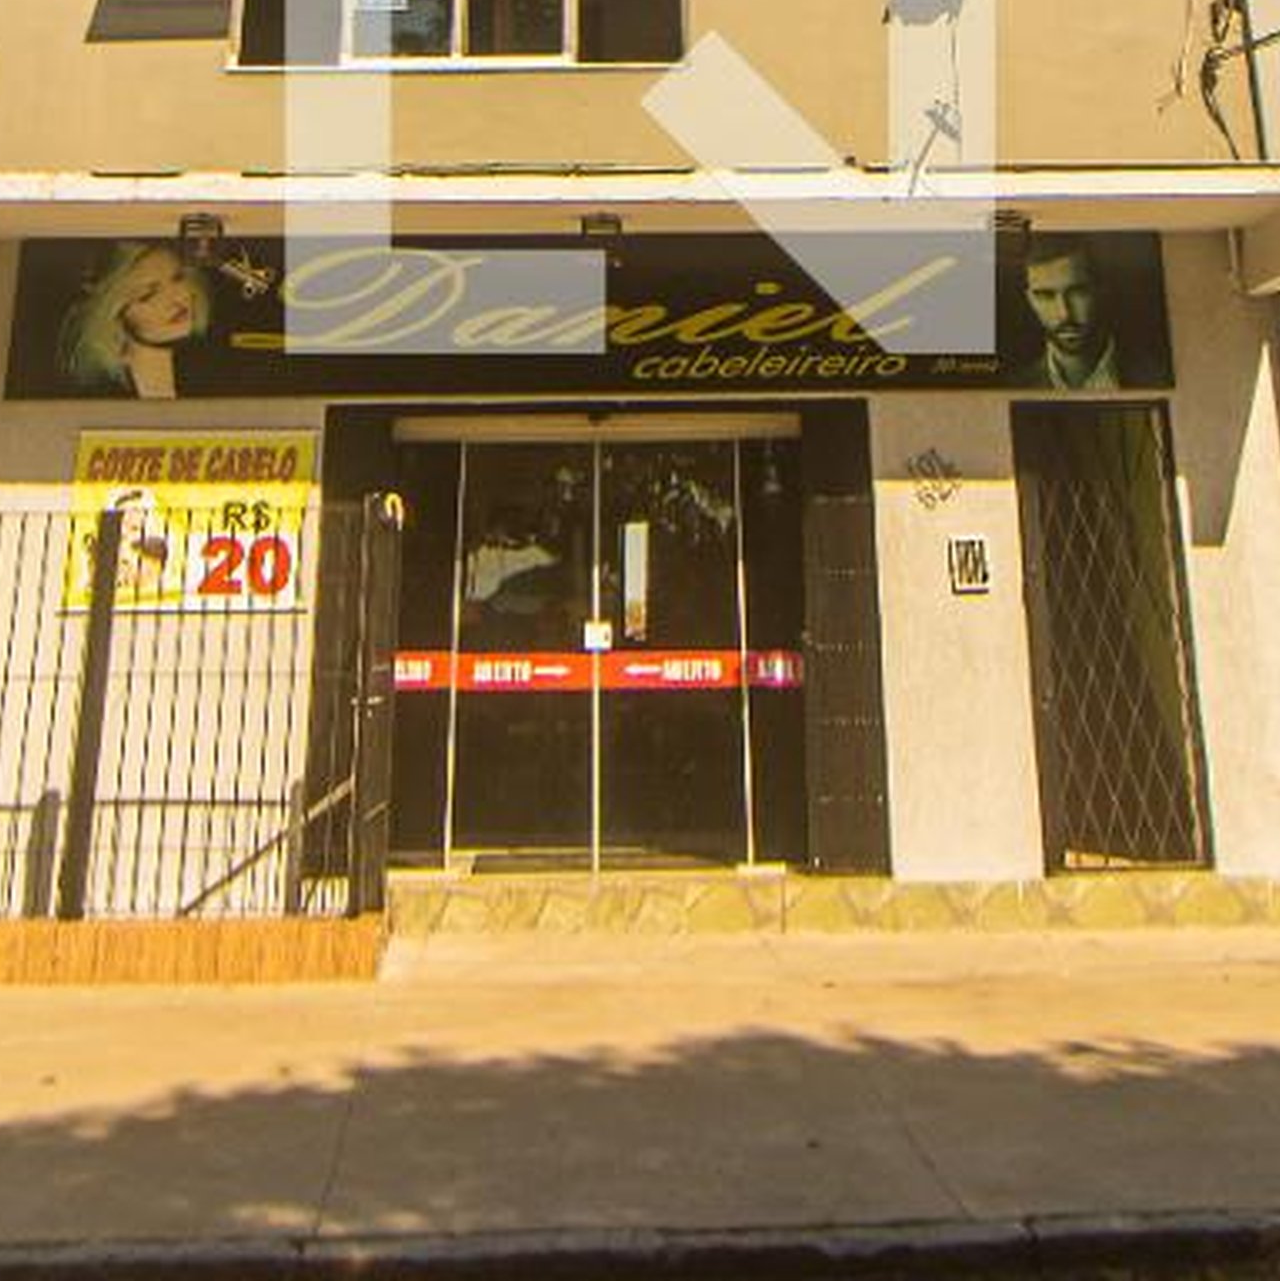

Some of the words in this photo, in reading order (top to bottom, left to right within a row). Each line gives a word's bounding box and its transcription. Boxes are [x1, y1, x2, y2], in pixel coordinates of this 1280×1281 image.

[231, 246, 958, 346] Daniel
[632, 344, 907, 380] cabeleireiro
[88, 446, 166, 482] CORTE
[168, 446, 203, 482] DE
[204, 446, 298, 482] CABELO
[221, 500, 271, 533] R$
[197, 535, 291, 596] 20
